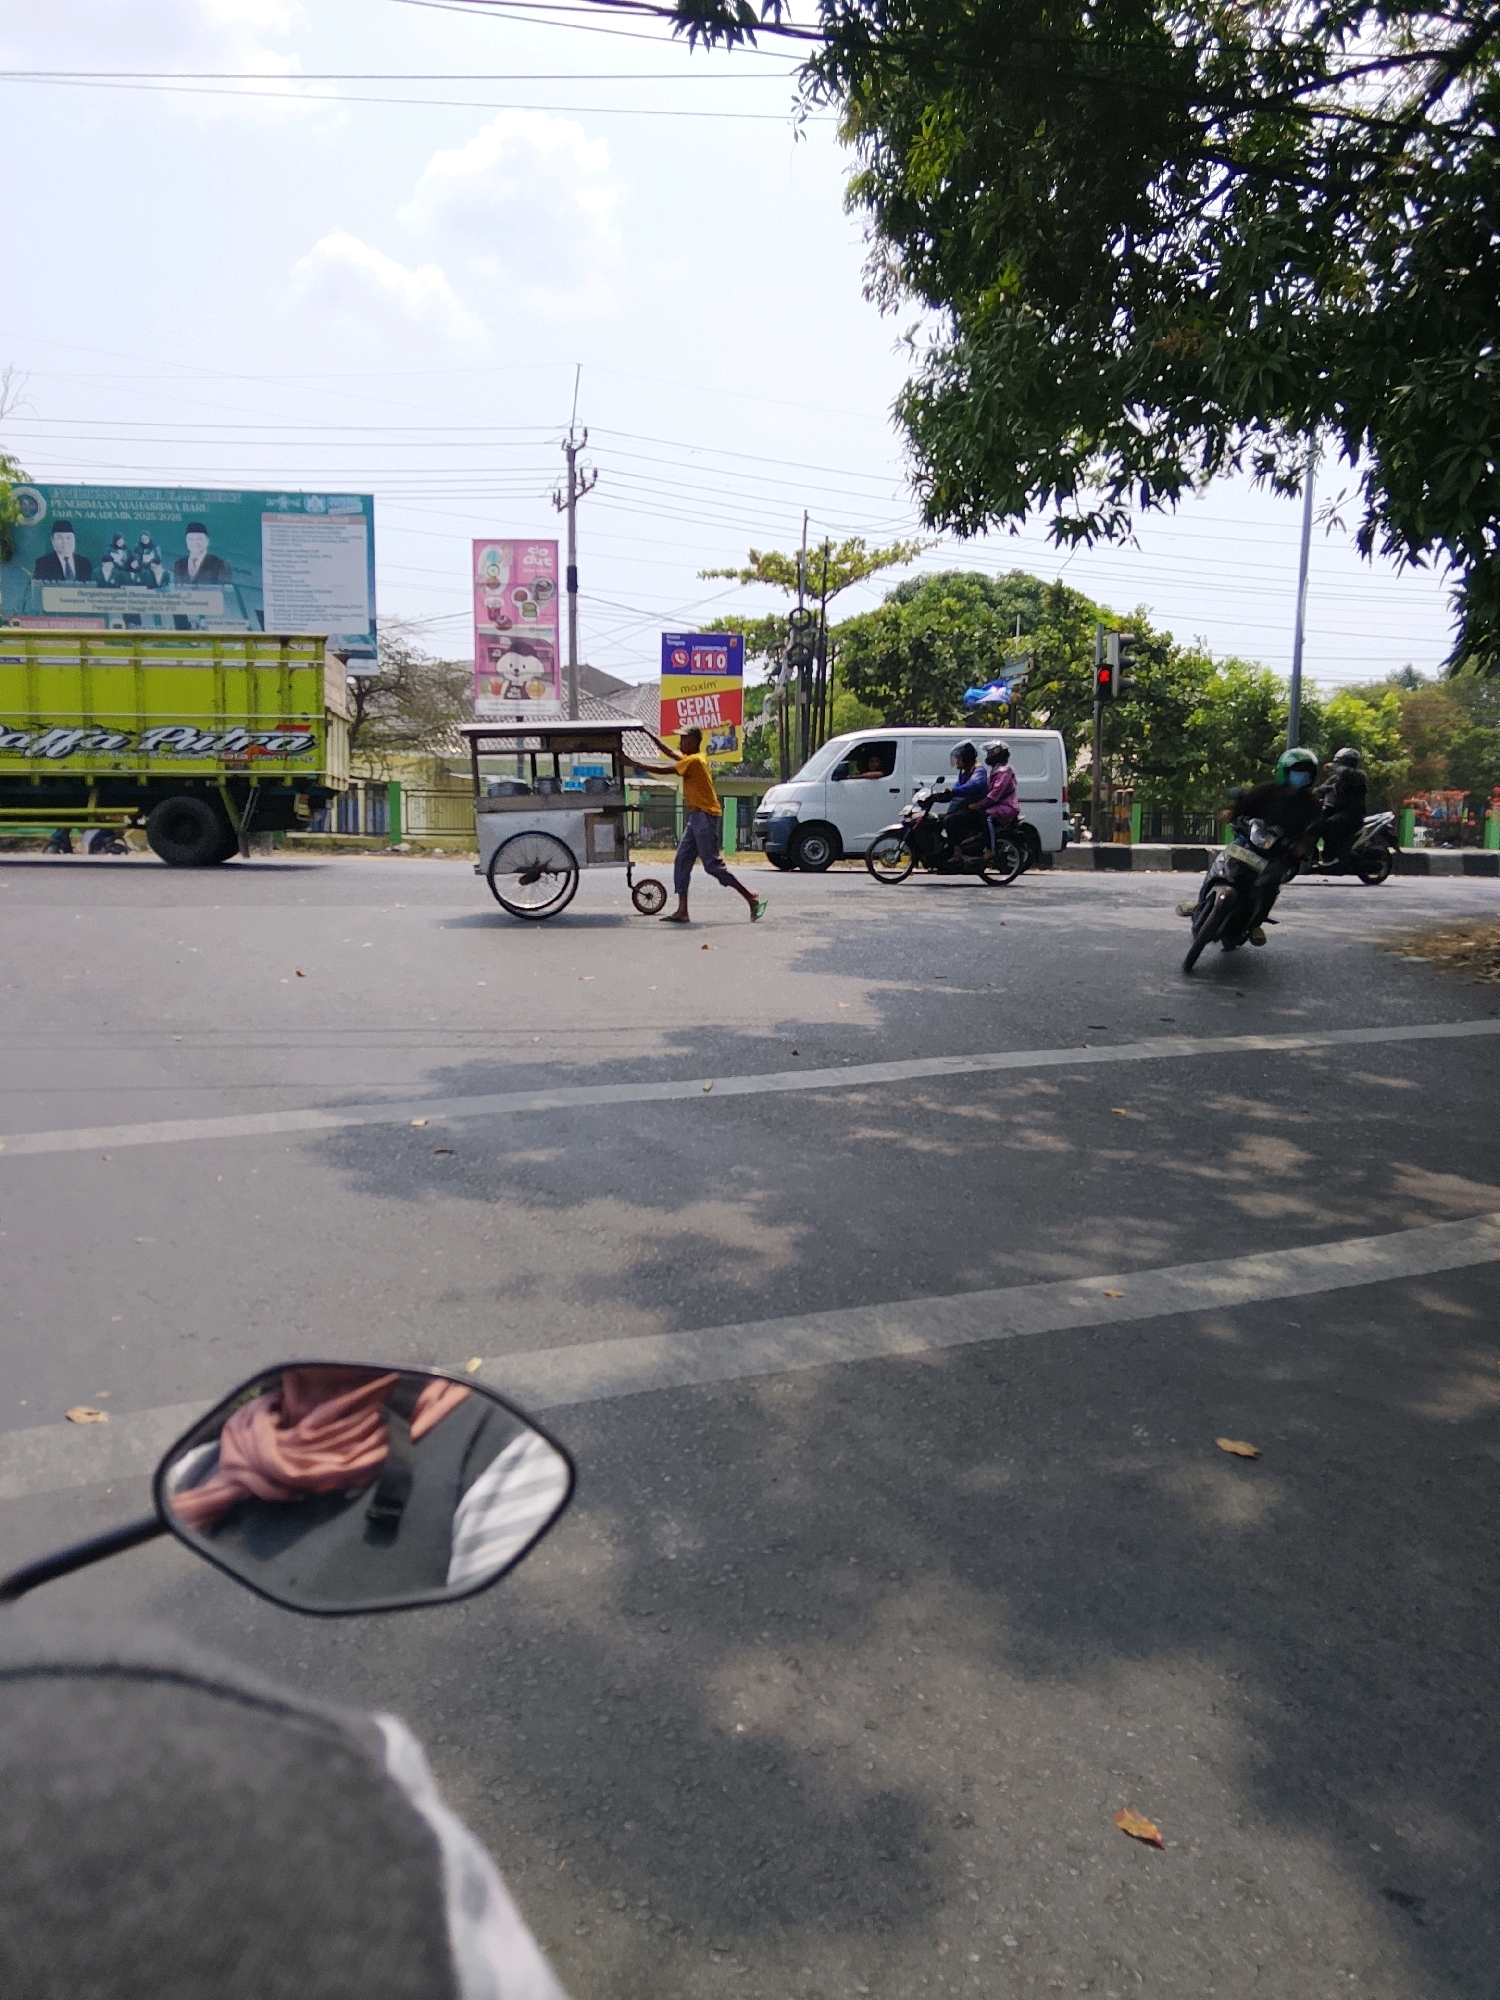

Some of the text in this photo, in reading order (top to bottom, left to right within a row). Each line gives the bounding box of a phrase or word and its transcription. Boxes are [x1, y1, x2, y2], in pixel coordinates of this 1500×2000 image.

[693, 652, 726, 669] 110
[680, 681, 717, 693] maxim
[676, 693, 720, 718] CEPAT
[678, 712, 722, 729] SAMPAI
[0, 725, 131, 759] affa
[138, 726, 316, 754] Putra
